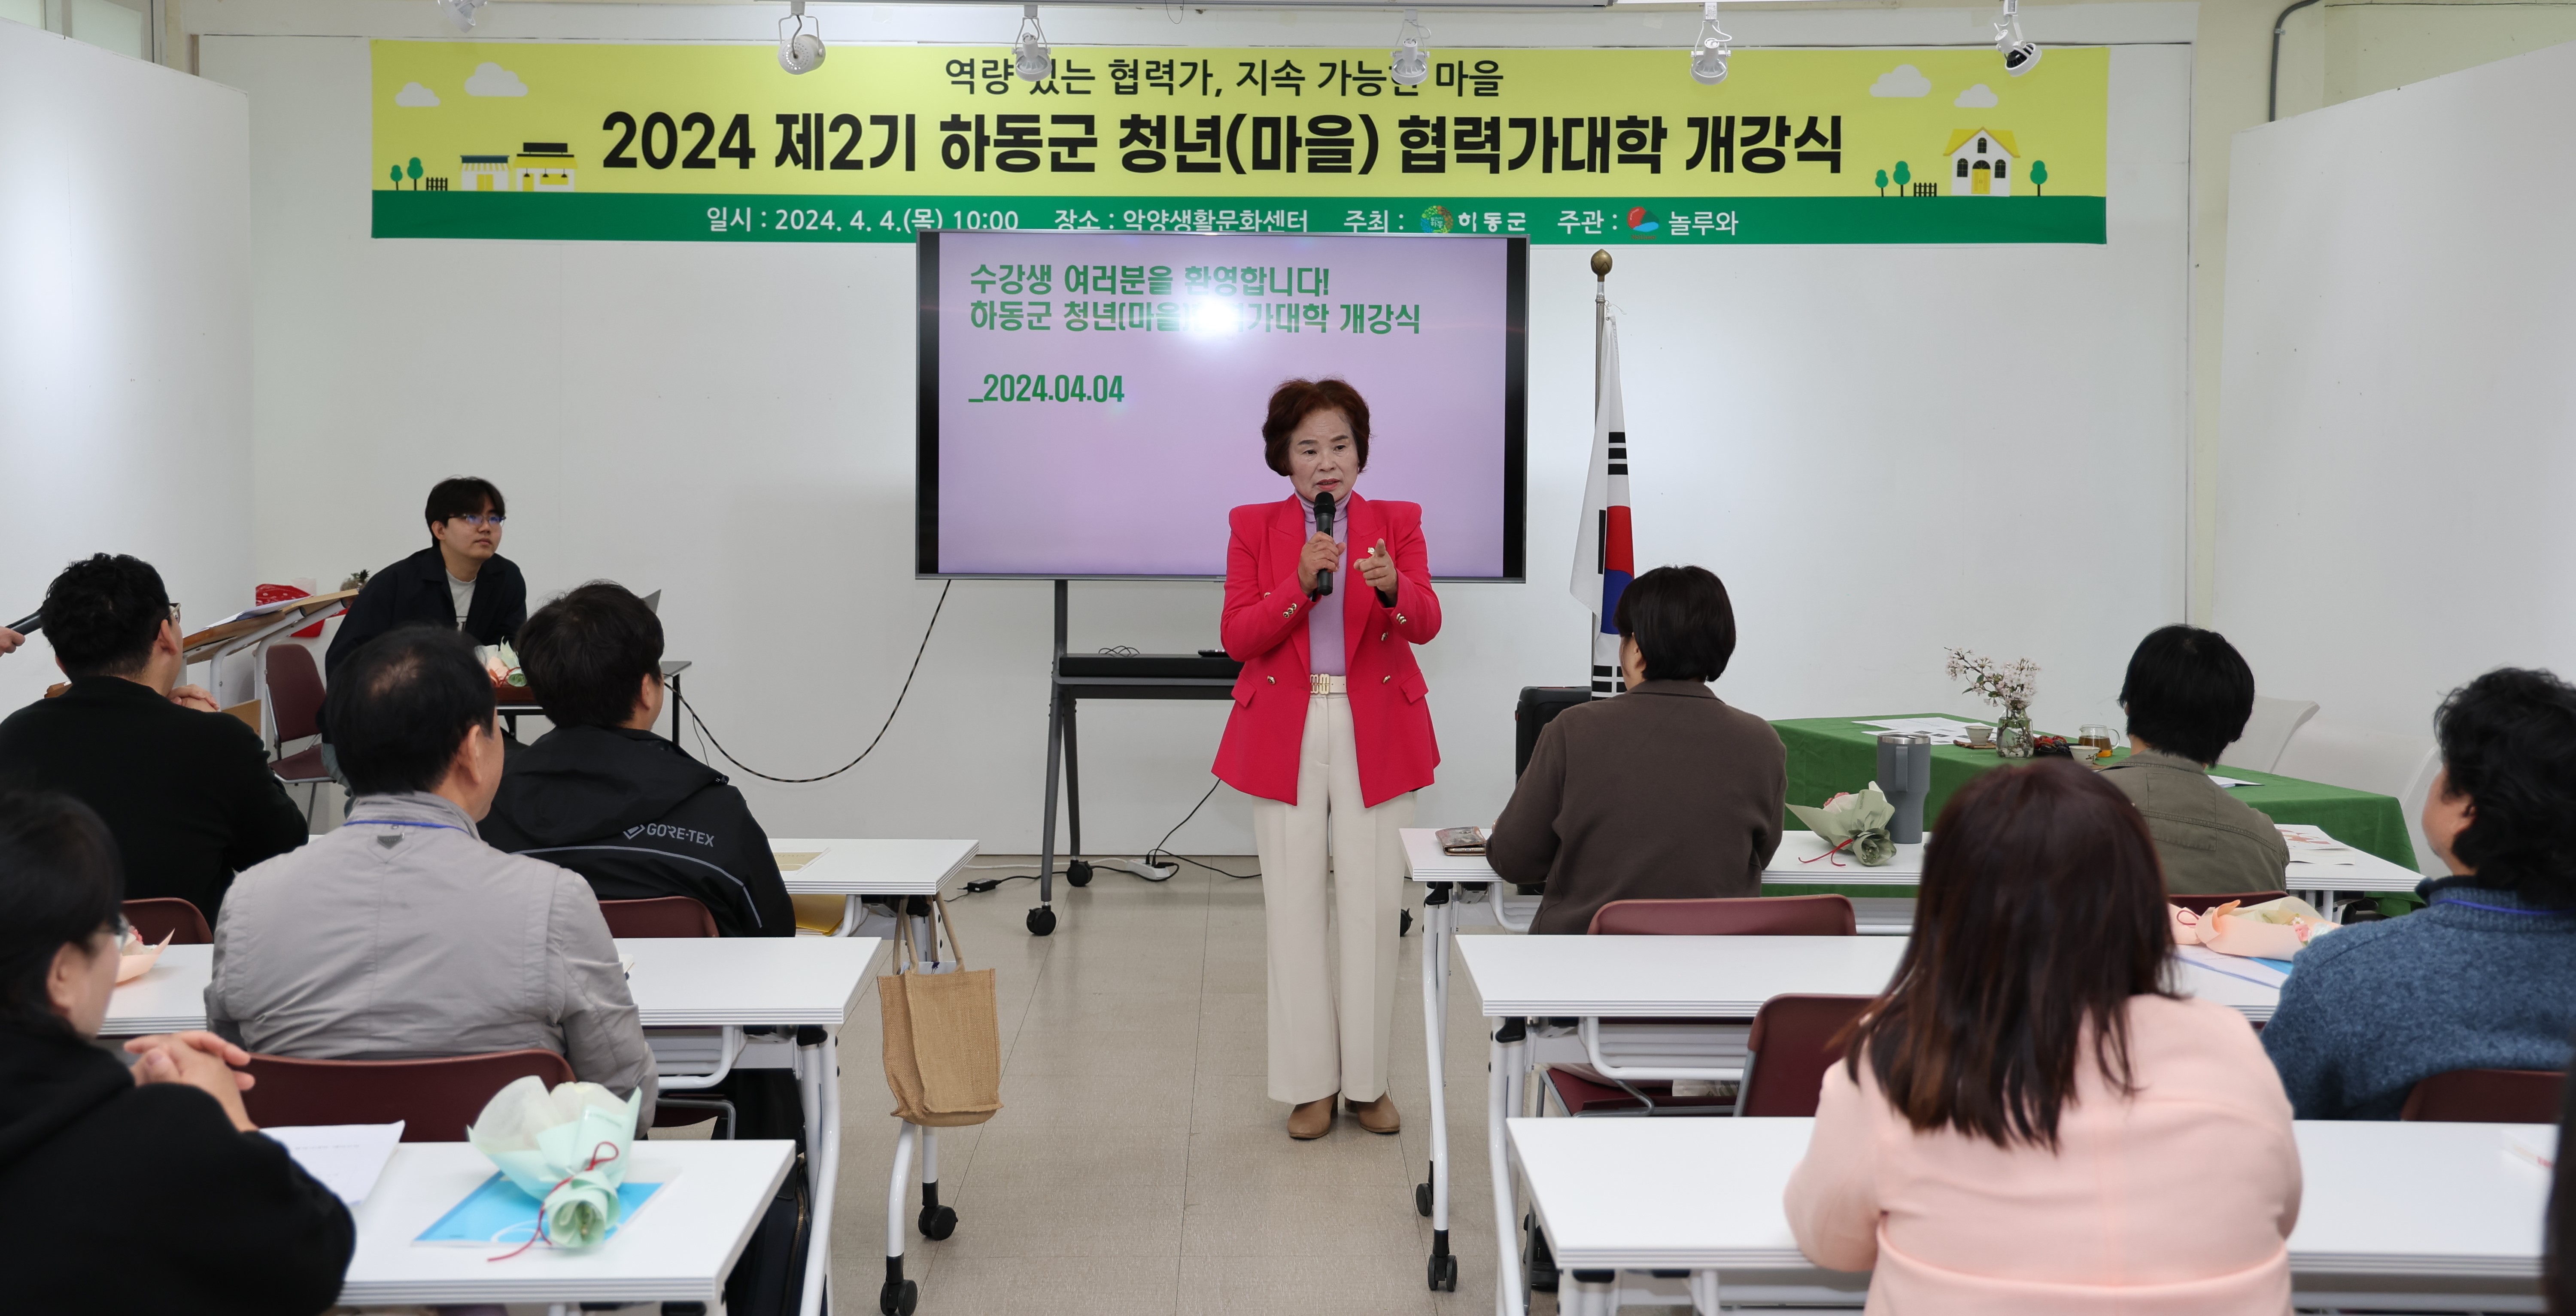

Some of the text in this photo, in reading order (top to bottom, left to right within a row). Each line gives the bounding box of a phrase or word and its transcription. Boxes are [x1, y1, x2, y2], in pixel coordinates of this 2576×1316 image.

[946, 58, 1014, 94] 역량
[1108, 59, 1222, 97] 협력가,
[1236, 59, 1306, 97] 지속
[1436, 60, 1504, 97] 마을
[602, 111, 1841, 175] 2024 제2기 하동군 청년(마을) 협력가대학 개강식
[707, 207, 750, 232] 일시
[775, 210, 841, 231] 2024.
[954, 210, 1018, 229] 10:00
[1054, 209, 1101, 230] 장소
[1123, 209, 1307, 232] 악양생활문화센터
[1344, 210, 1388, 233] 주최
[1558, 210, 1604, 234] 주관
[1668, 211, 1739, 236] 놀루와
[971, 264, 1330, 297] 수강생 여러분을 환영합니다!
[970, 300, 1052, 331] 하동군
[1340, 304, 1420, 334] 개강식
[968, 374, 1125, 403] _2024.04.04
[647, 823, 715, 848] GORE-TEX
